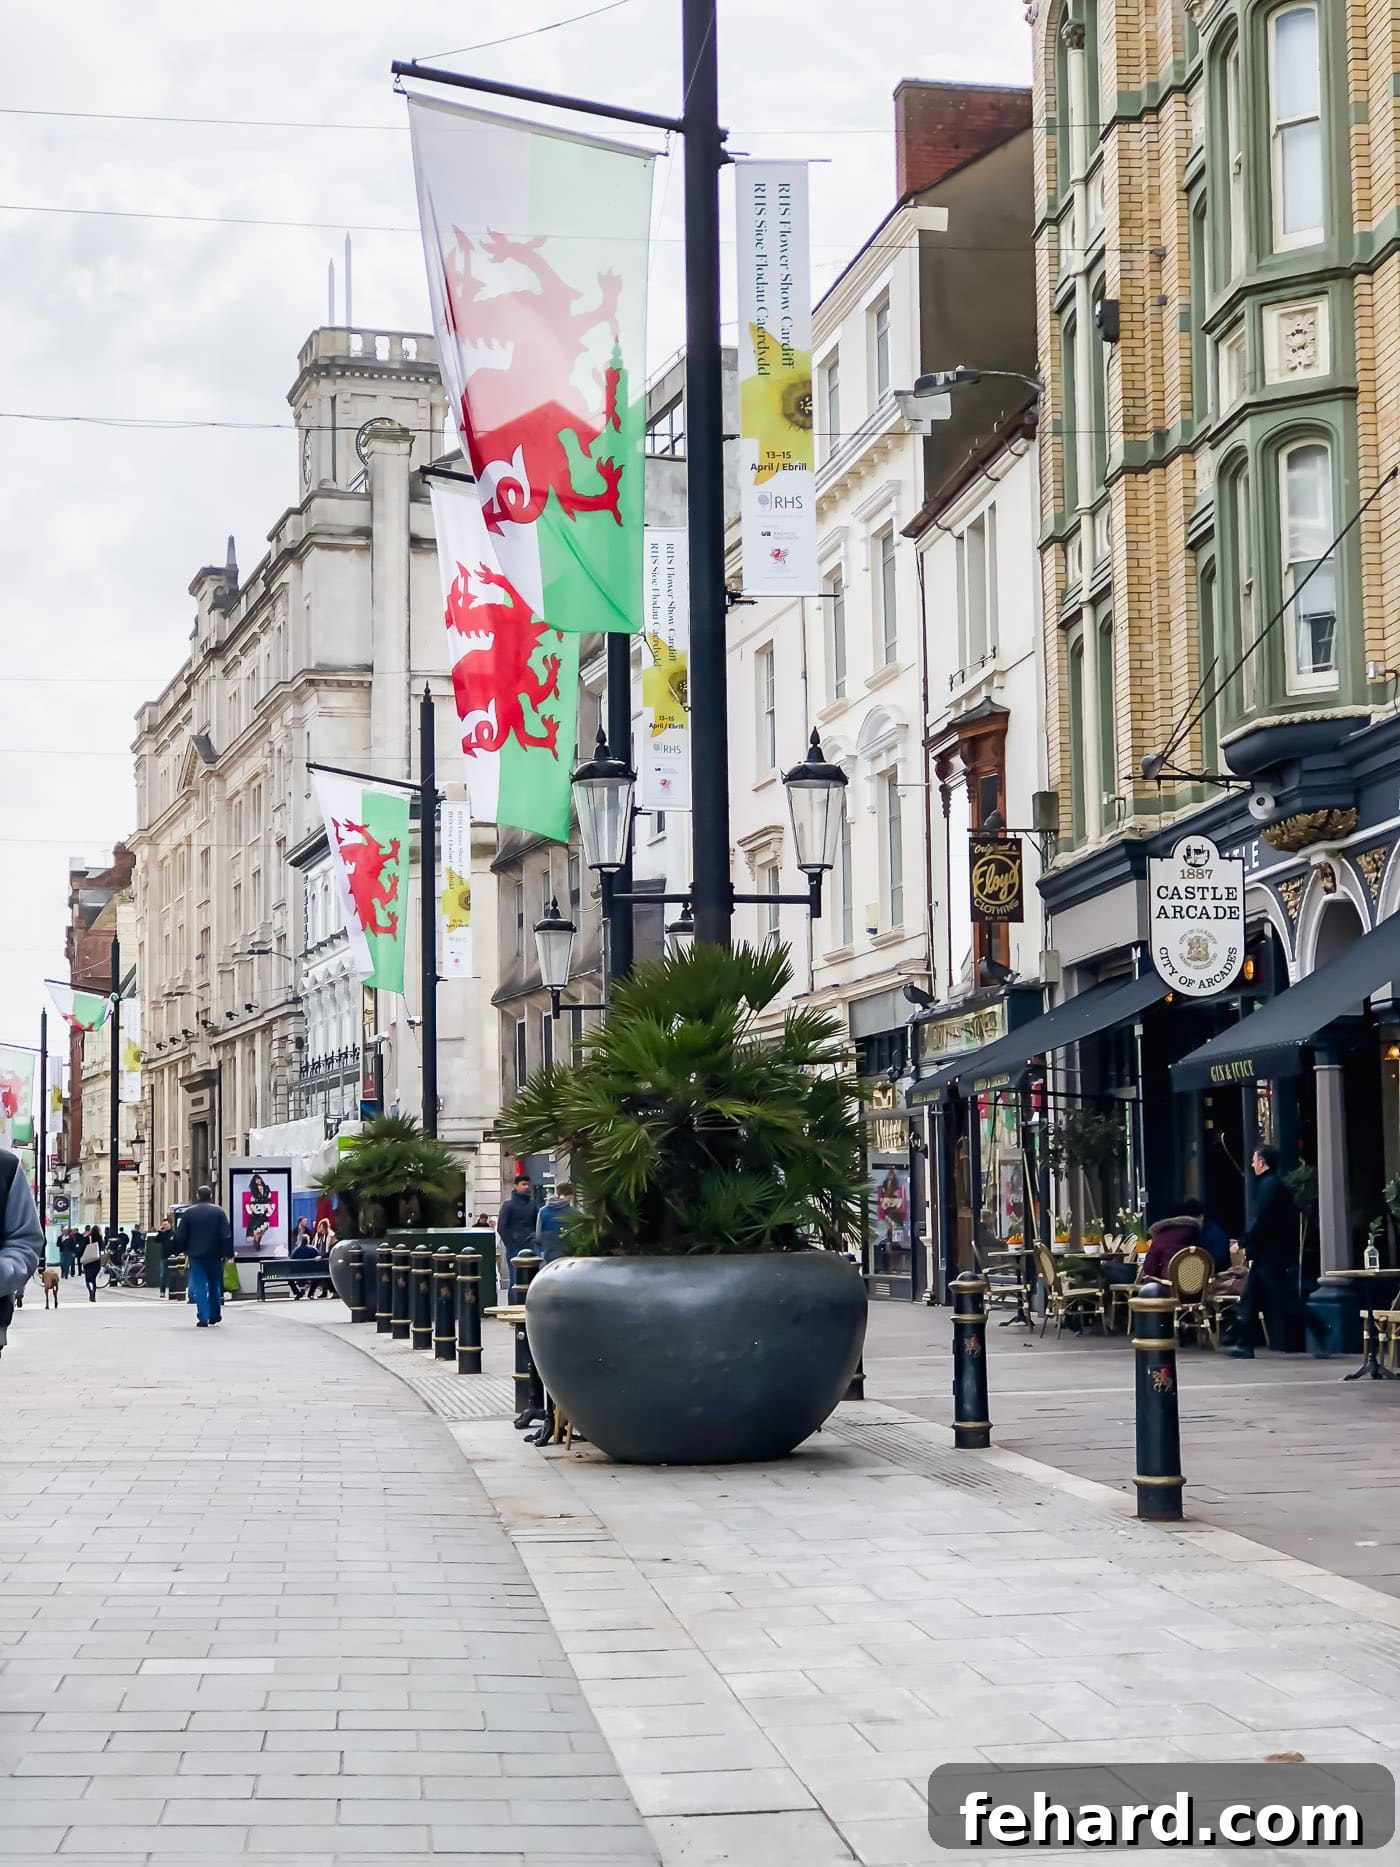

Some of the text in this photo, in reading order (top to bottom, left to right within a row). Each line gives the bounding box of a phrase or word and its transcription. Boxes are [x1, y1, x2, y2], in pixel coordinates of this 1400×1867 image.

[754, 184, 770, 376] RHS Sioe Flodau Caerdydd
[778, 184, 793, 368] RHS Flower Show Cardiff
[750, 462, 807, 472] April / Ebrill
[774, 496, 803, 509] RHS
[650, 543, 659, 565] RHS
[666, 543, 674, 565] RHS
[667, 567, 675, 597] Flower
[668, 599, 676, 625] Show
[664, 744, 682, 754] RHS
[972, 859, 1020, 900] Floyd
[1180, 869, 1213, 879] 1887
[1156, 886, 1237, 901] CASTLE
[974, 897, 1019, 915] CLOTHING
[1156, 906, 1240, 920] ARCADE
[1159, 946, 1179, 977] CITY
[1178, 975, 1195, 988] OF
[1198, 947, 1237, 989] ARCADES
